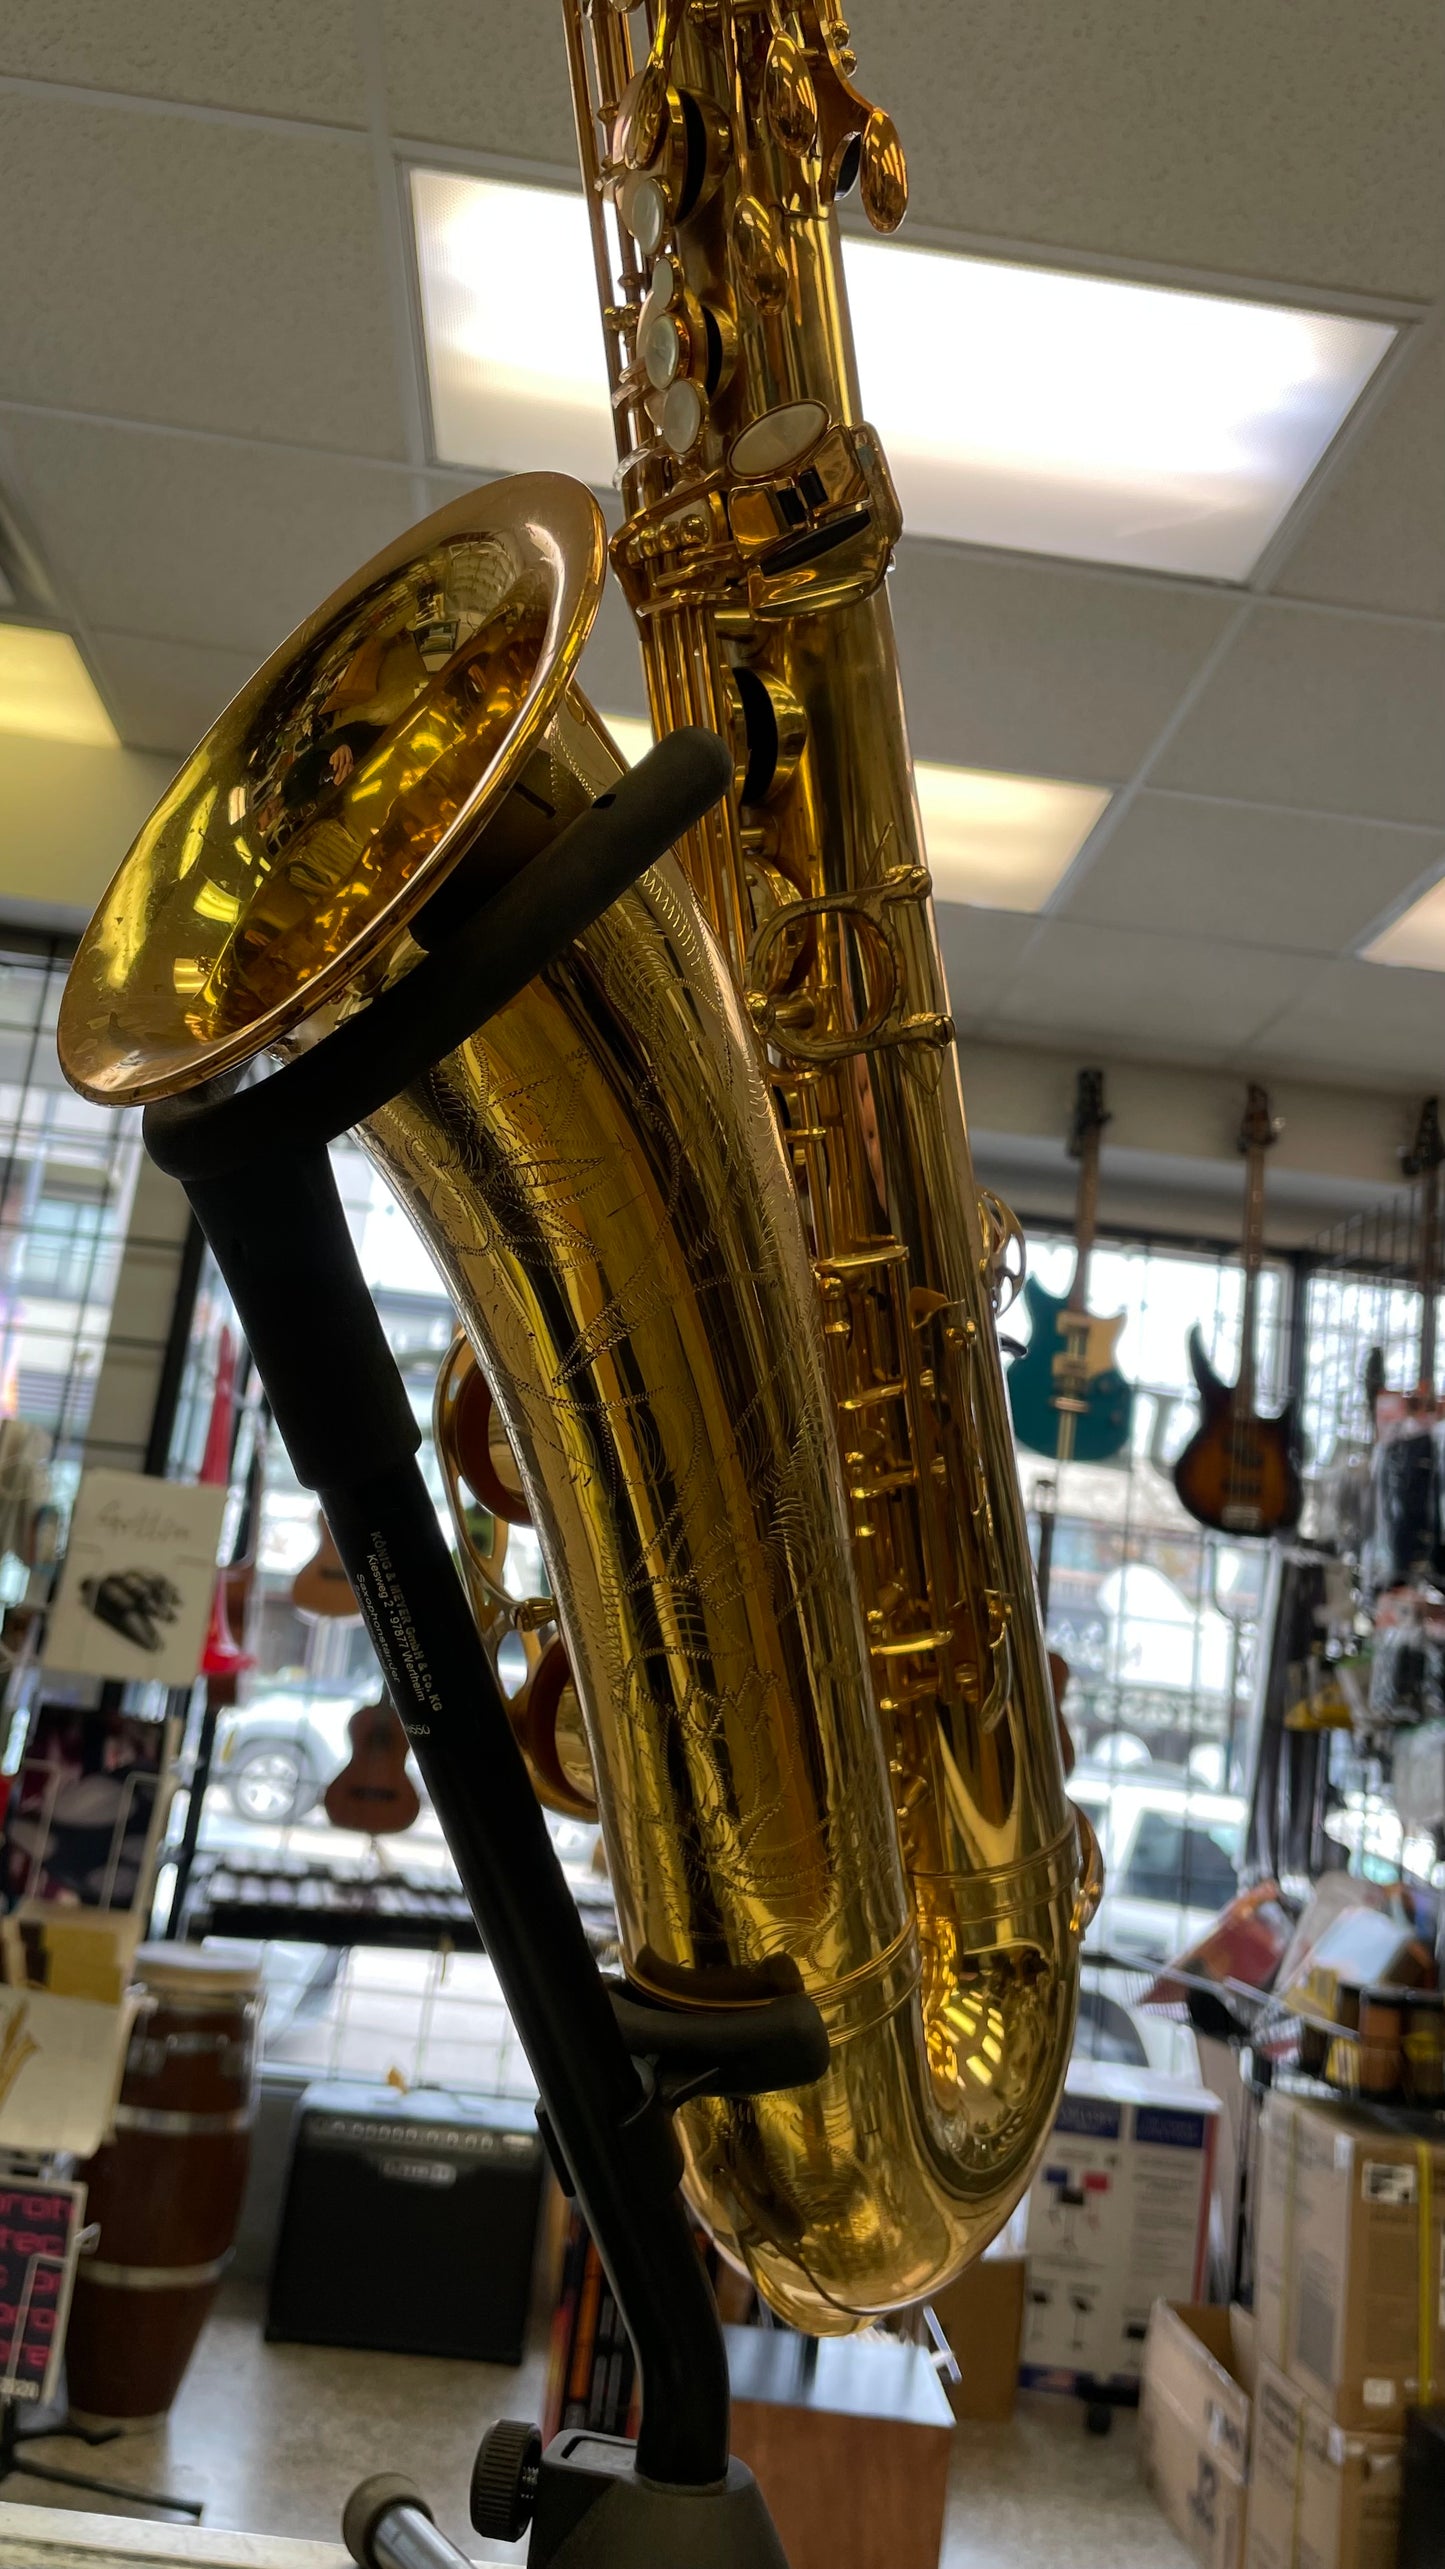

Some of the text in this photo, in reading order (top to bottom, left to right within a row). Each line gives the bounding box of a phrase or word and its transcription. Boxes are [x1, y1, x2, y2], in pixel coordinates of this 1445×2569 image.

[366, 1553, 425, 1702] Kiesweg 2 97877 Wertheim
[370, 1530, 443, 1712] KÖNIG & MEYER GmbH & Co. KG
